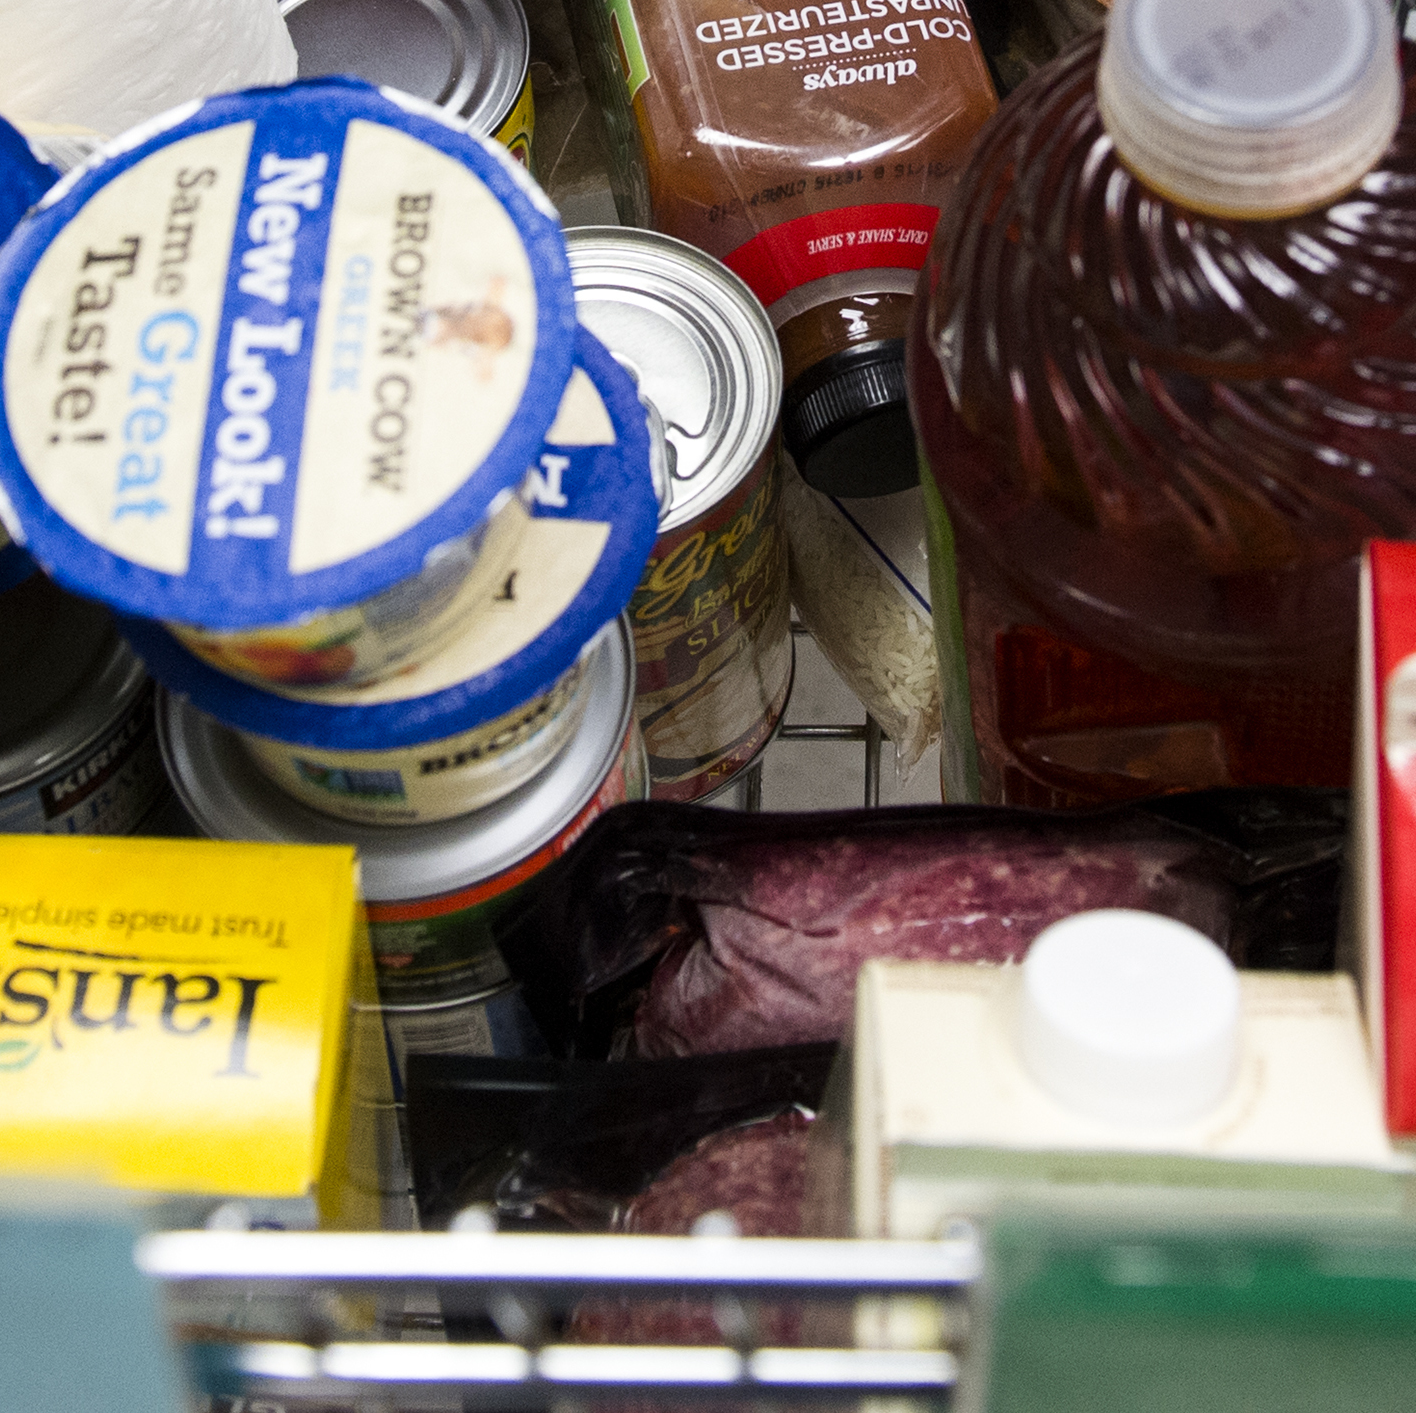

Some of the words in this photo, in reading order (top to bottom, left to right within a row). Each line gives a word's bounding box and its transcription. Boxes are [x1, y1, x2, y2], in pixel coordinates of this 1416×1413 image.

[715, 16, 972, 72] COLD-PRESSED
[804, 59, 917, 91] always
[154, 166, 219, 297] Same
[239, 153, 328, 305] New
[807, 238, 844, 255] SERVE
[846, 232, 857, 245] &
[858, 227, 894, 245] SHAKE
[895, 229, 929, 247] CRAFT,
[381, 191, 432, 357] BROWN
[47, 234, 141, 448] Taste!
[113, 310, 202, 524] Great
[205, 318, 302, 539] Look!
[366, 372, 413, 494] COW
[107, 908, 201, 937] made
[208, 917, 291, 949] Trust
